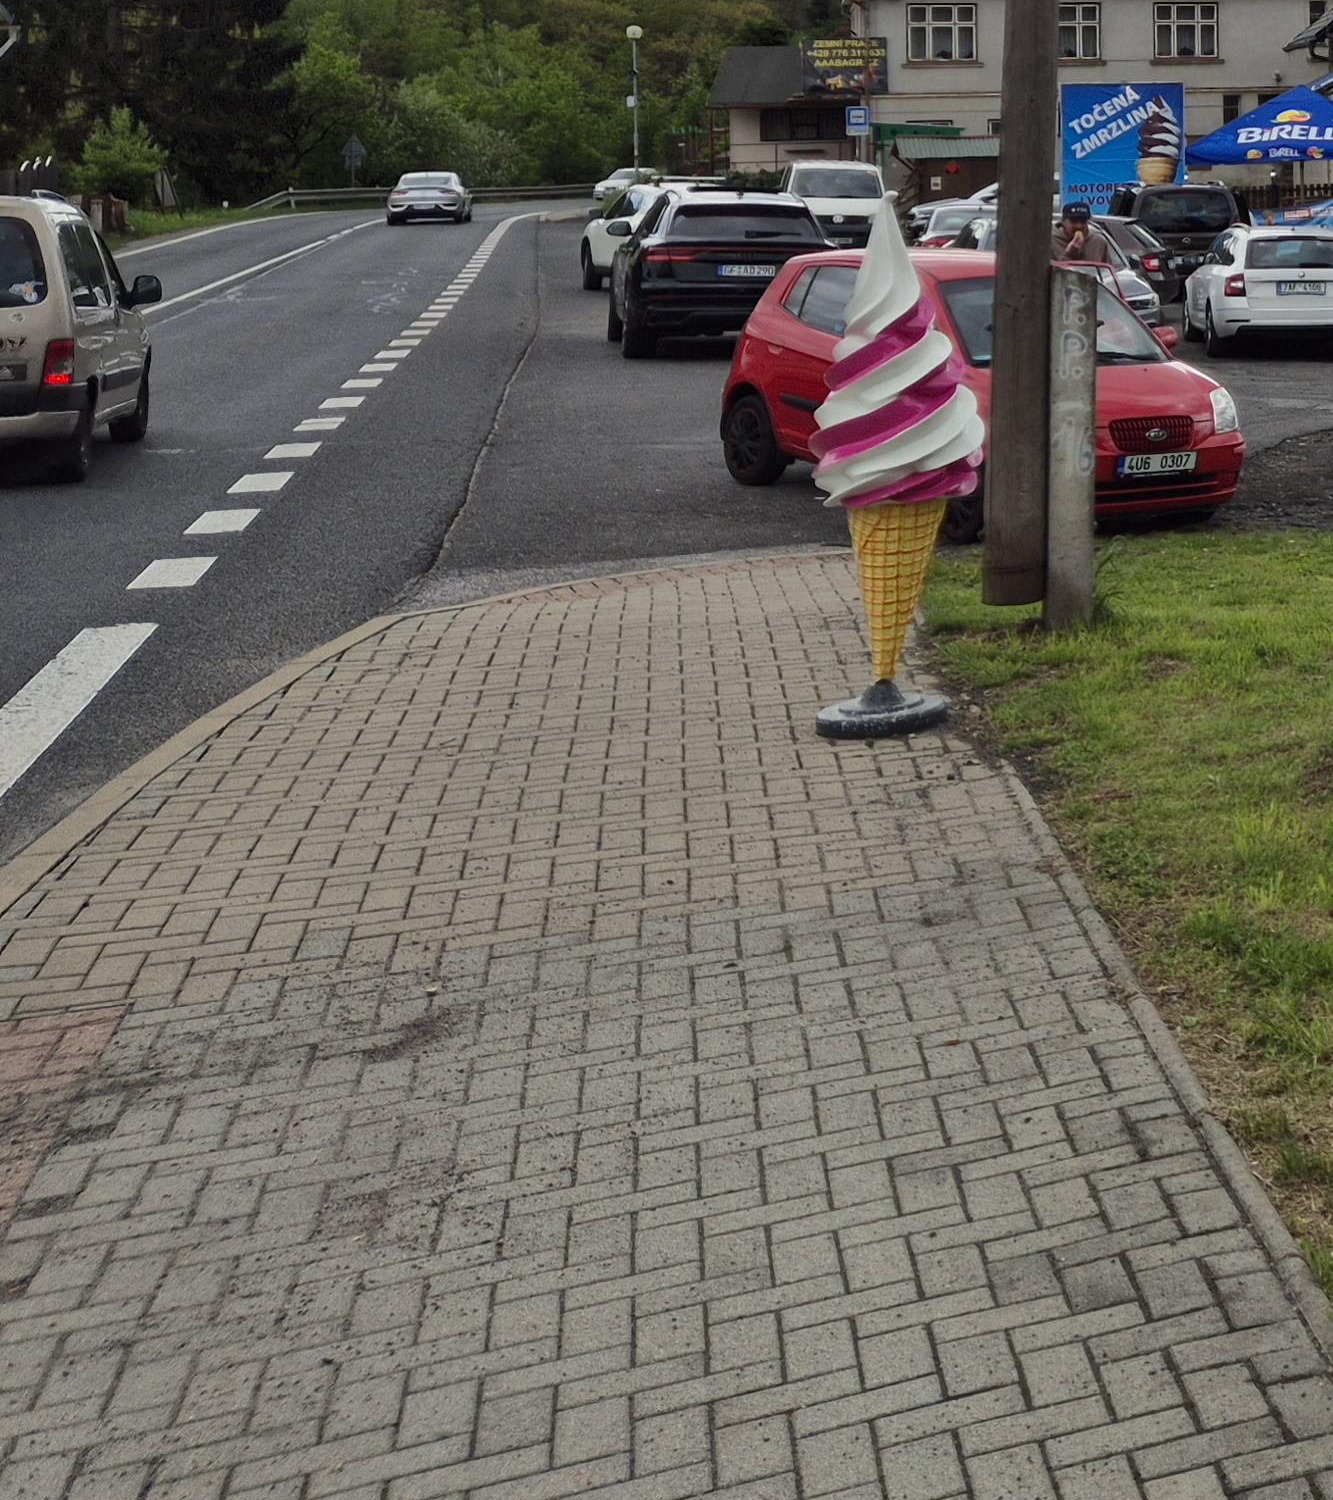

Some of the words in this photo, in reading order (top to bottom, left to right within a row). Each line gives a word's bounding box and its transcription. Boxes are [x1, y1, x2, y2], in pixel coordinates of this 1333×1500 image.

[1071, 101, 1161, 159] ZMRZLINA
[1127, 456, 1151, 471] 4U6
[1160, 453, 1191, 469] 0307
